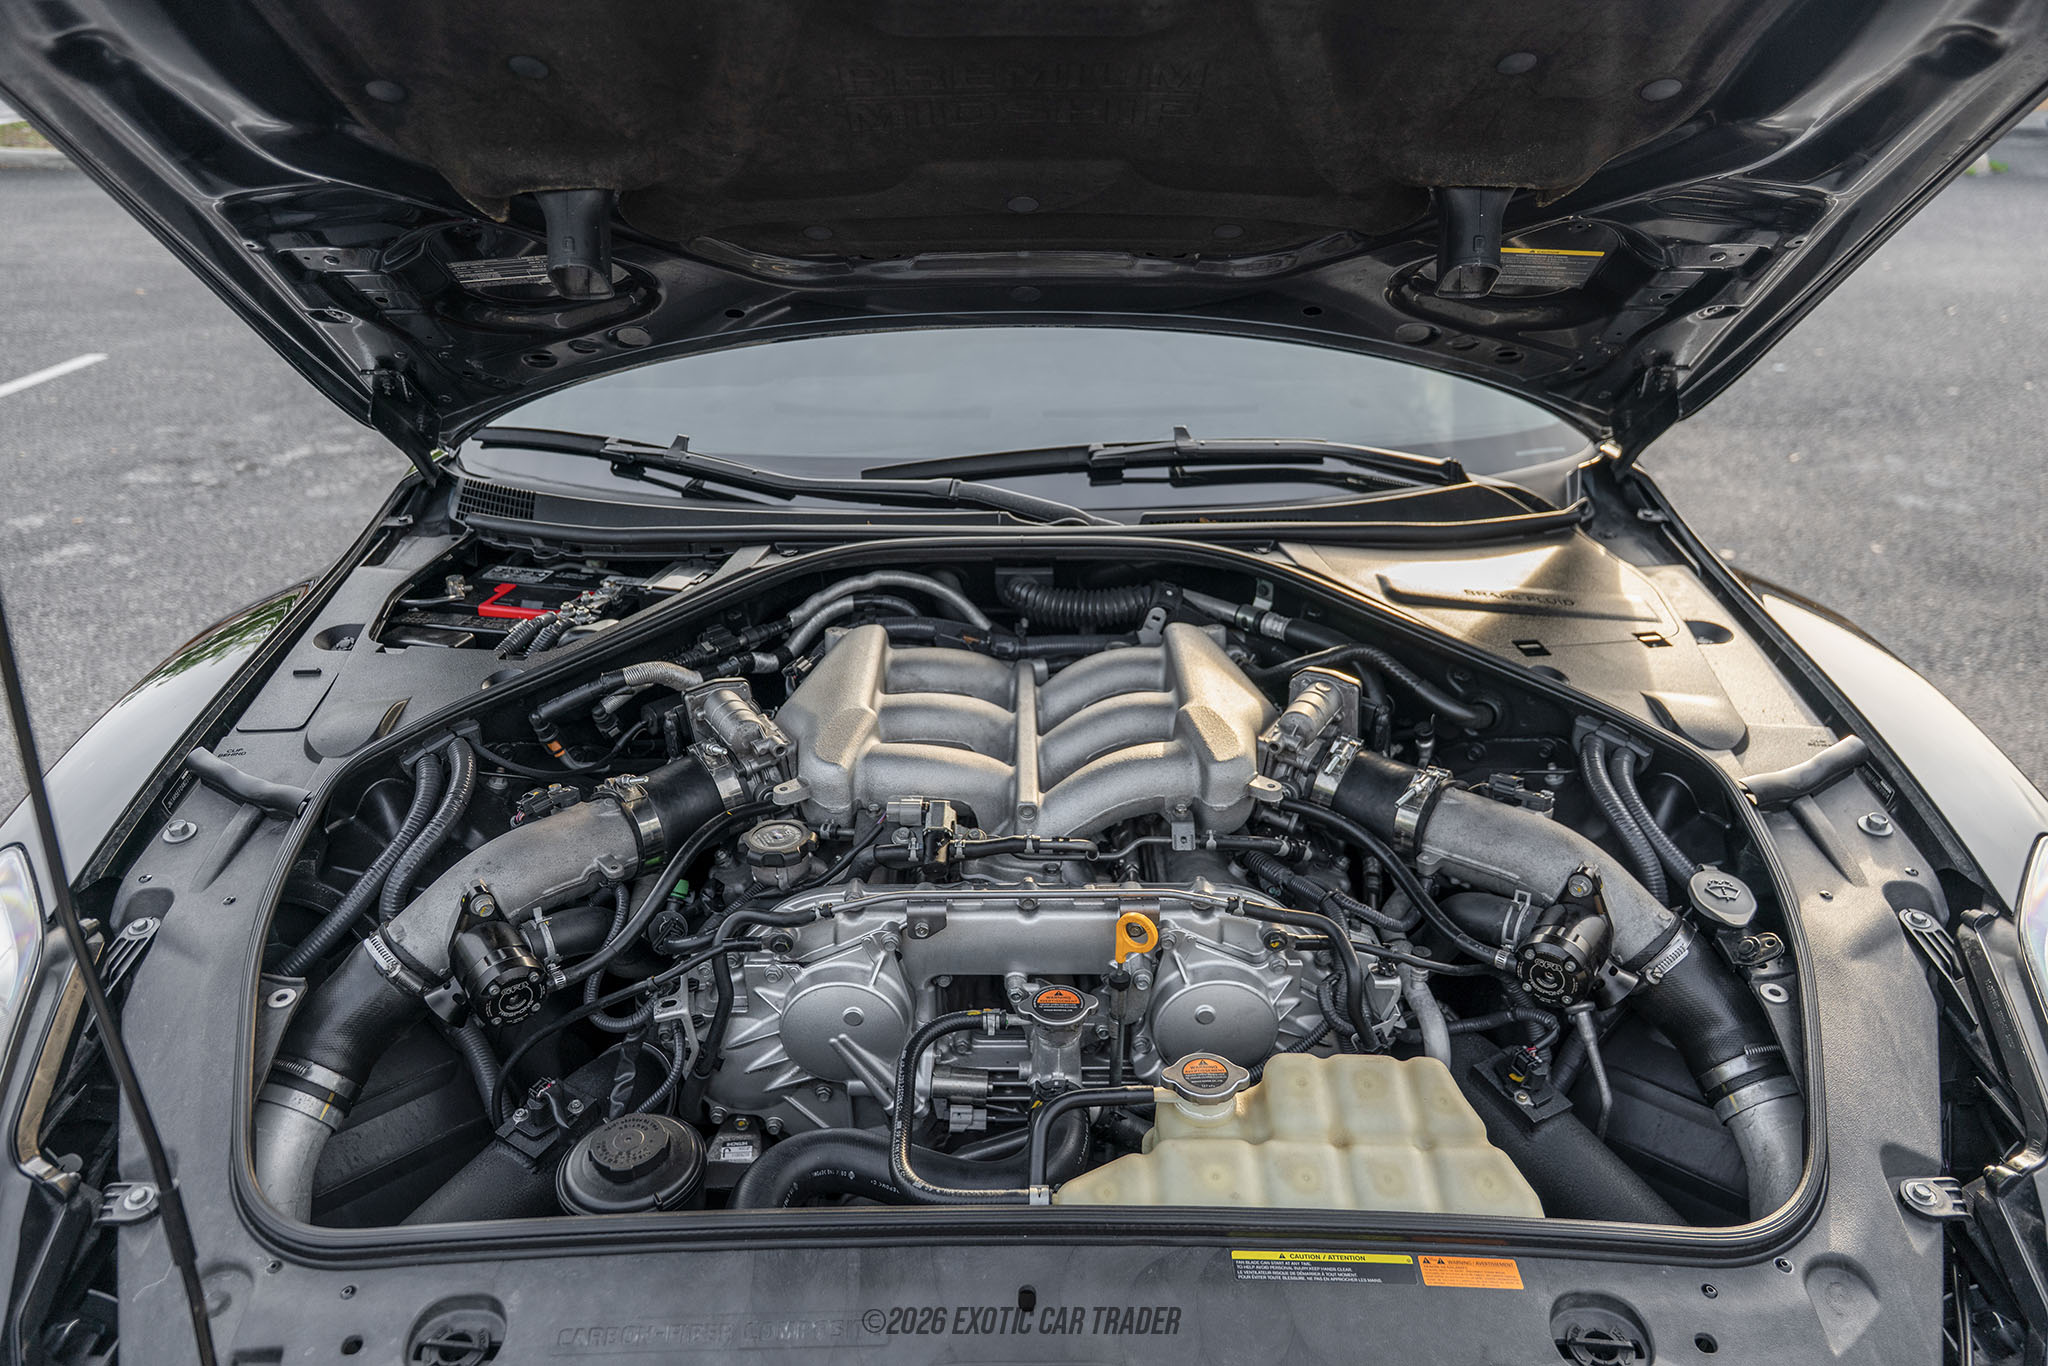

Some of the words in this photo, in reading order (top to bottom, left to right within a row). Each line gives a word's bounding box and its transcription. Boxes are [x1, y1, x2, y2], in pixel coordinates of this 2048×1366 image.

[840, 62, 1208, 90] PREMIUM
[1464, 589, 1522, 601] BRAKE
[1526, 595, 1575, 607] FLUID
